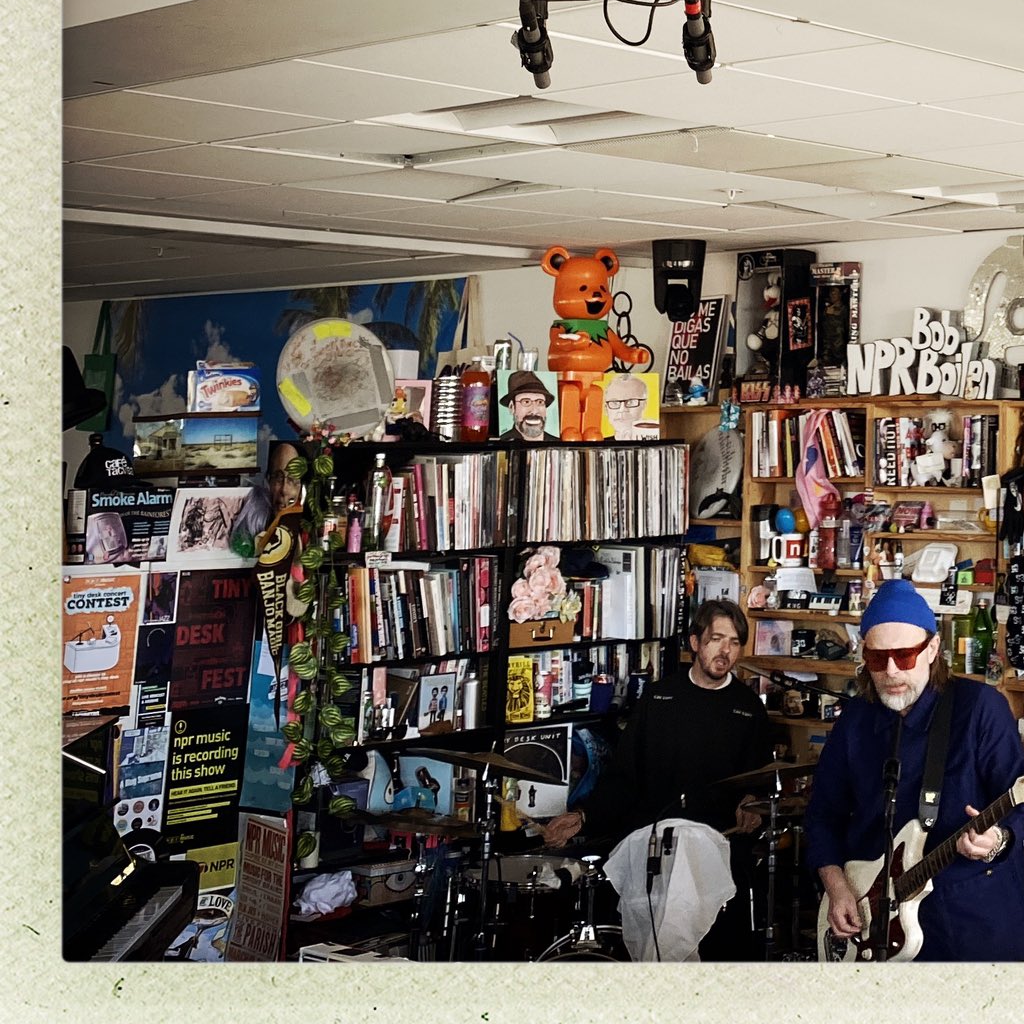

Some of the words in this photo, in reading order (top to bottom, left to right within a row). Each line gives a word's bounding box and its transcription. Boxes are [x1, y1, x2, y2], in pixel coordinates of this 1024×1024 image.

[698, 301, 717, 317] ME
[674, 317, 711, 334] DIGAS
[912, 307, 961, 355] Bob
[672, 334, 698, 349] QUE
[669, 350, 689, 365] NO
[847, 338, 916, 396] NPR
[667, 364, 710, 381] BAILAS
[916, 342, 997, 400] Boilen
[201, 377, 242, 397] Twinkies
[741, 381, 771, 402] KISS
[92, 493, 135, 507] Smoke
[137, 491, 173, 505] Alarm
[73, 592, 85, 600] tiny
[212, 578, 251, 599] TINY
[275, 573, 287, 620] BLACK
[67, 596, 129, 610] CONTEST
[257, 570, 275, 617] BANJO
[266, 617, 279, 656] MAGIC
[176, 624, 225, 646] DESK
[274, 621, 283, 647] GIRL
[201, 667, 246, 689] FEST
[173, 736, 194, 749] npr
[196, 728, 231, 745] music
[514, 735, 537, 743] DESK
[172, 752, 182, 765] is
[184, 746, 239, 764] recording
[171, 766, 192, 781] this
[194, 764, 226, 778] show
[209, 858, 235, 873] NPR
[210, 896, 231, 912] LOVE
